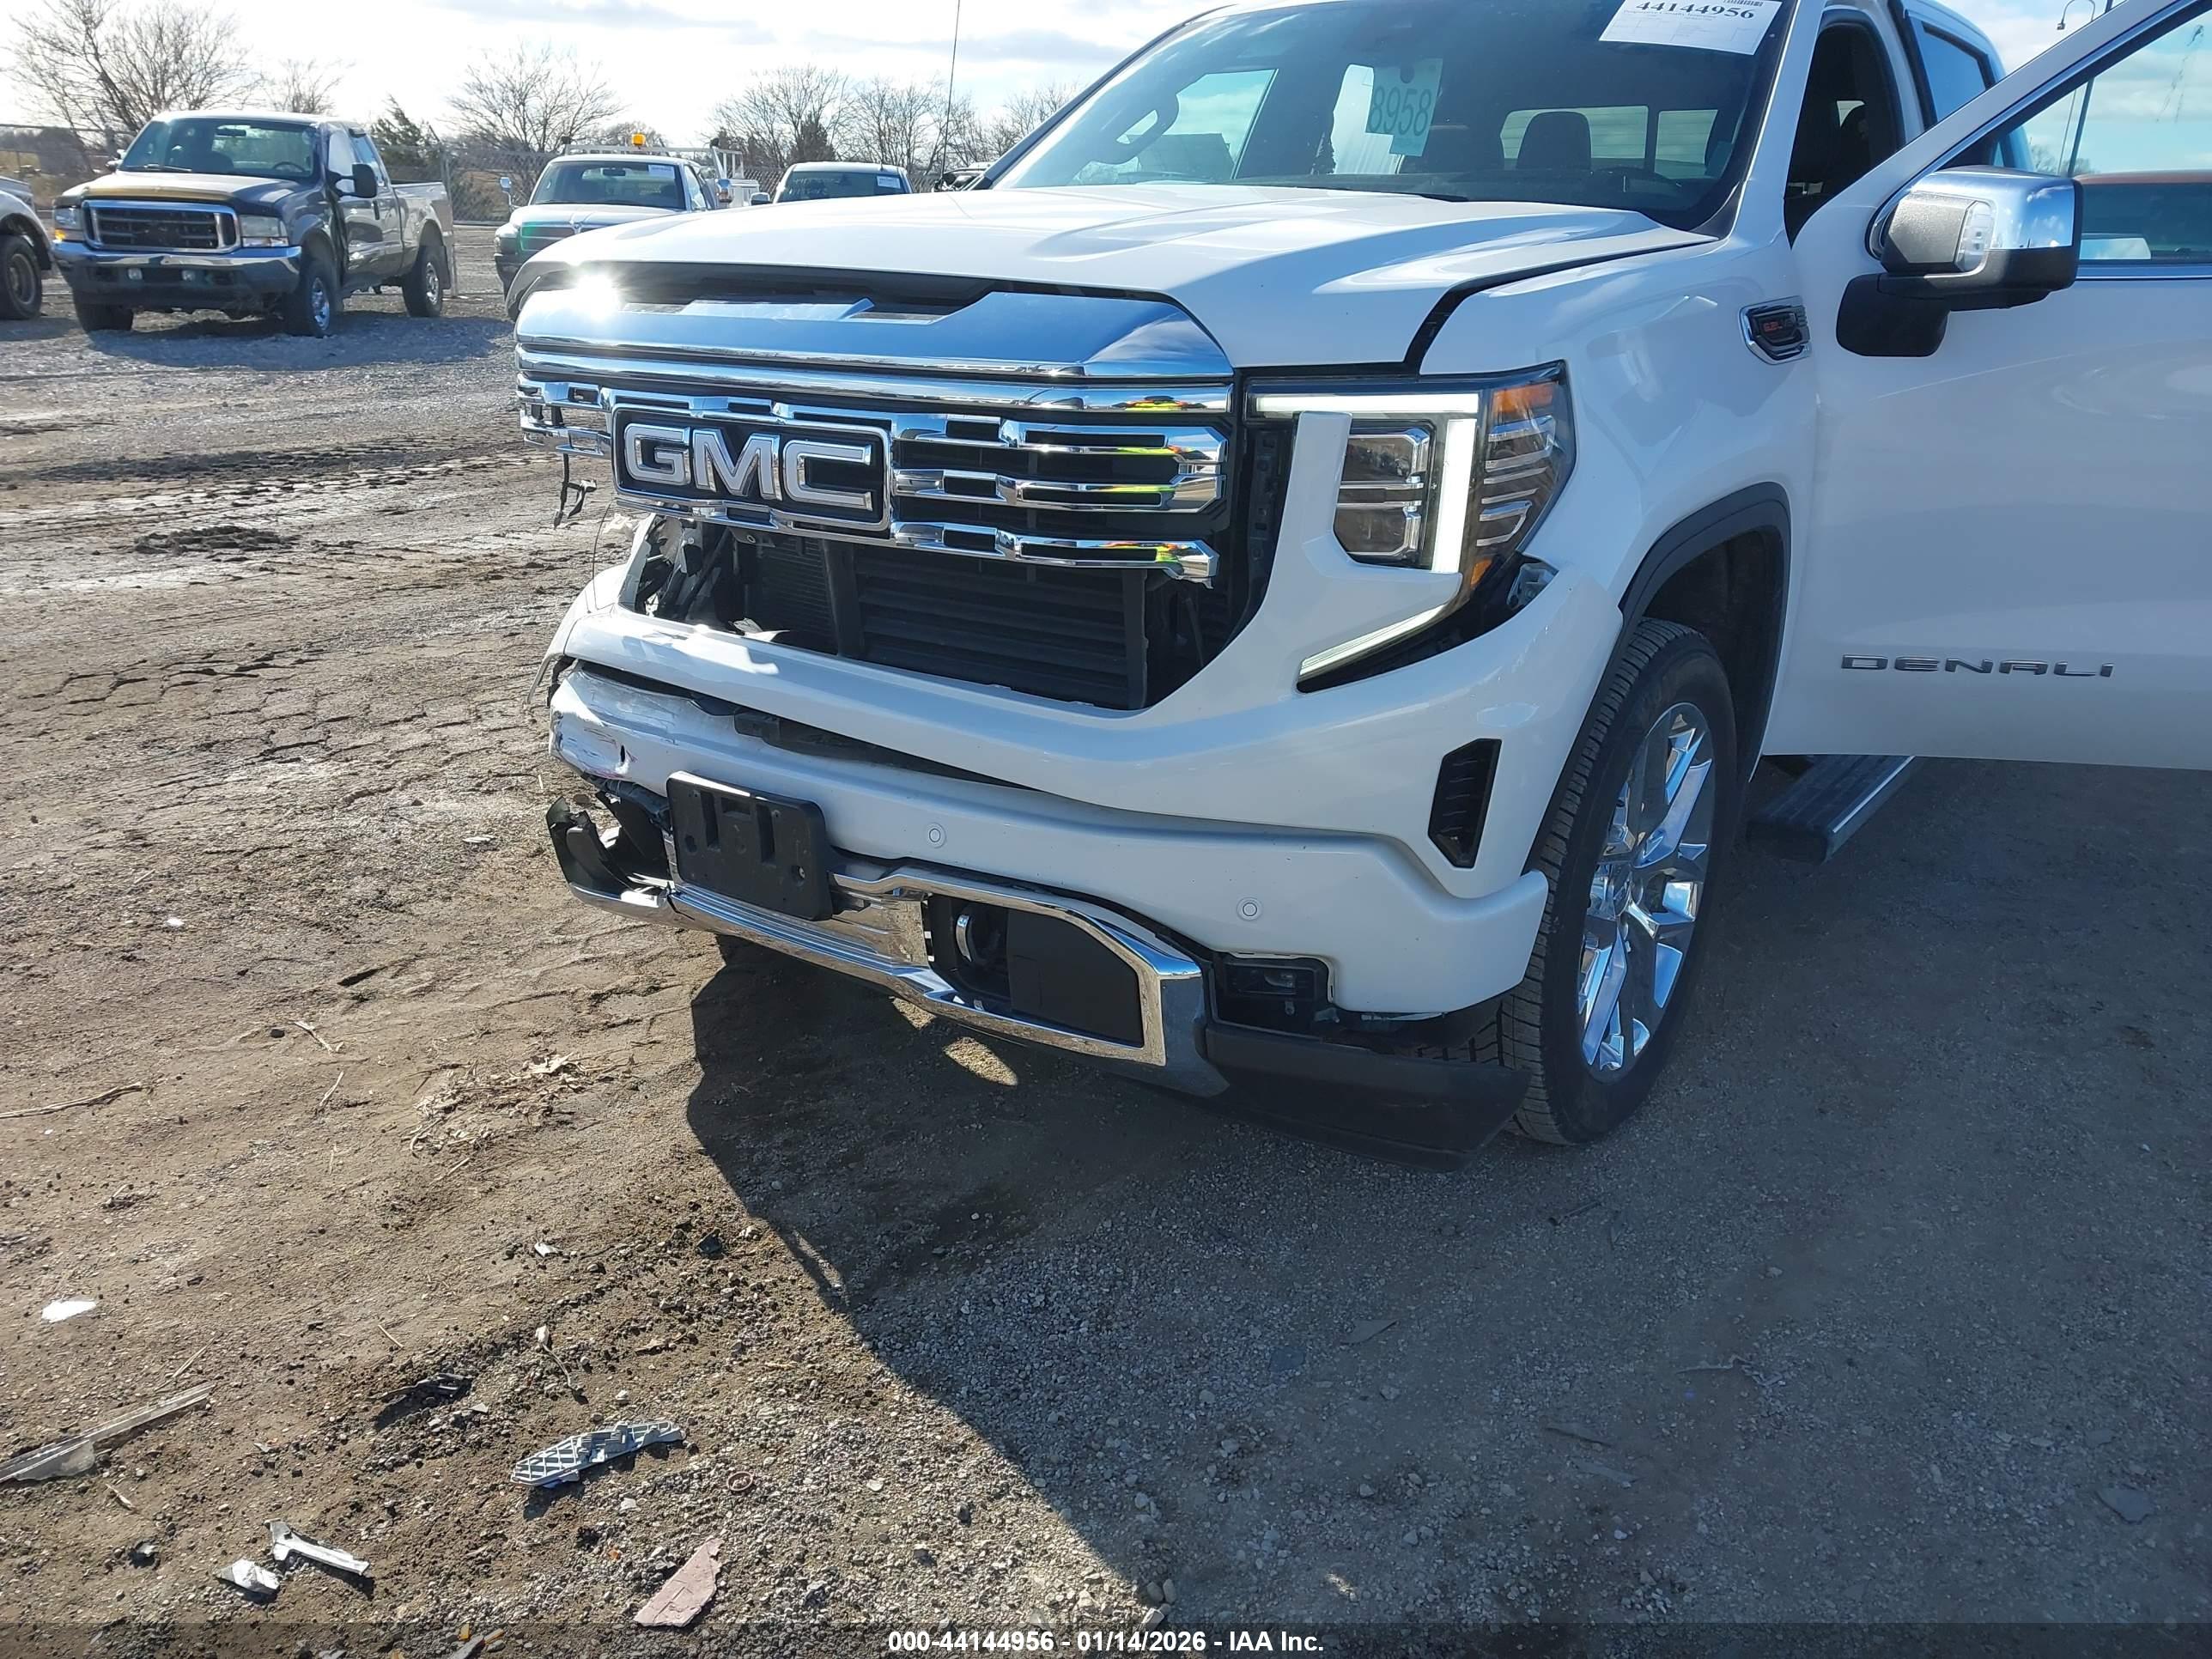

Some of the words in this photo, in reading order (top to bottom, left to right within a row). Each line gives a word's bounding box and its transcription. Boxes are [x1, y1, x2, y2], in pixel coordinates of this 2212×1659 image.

[1635, 1, 1757, 19] 44144956
[1367, 85, 1432, 137] 8958
[623, 422, 873, 513] GMC
[1840, 653, 2117, 678] DENALI
